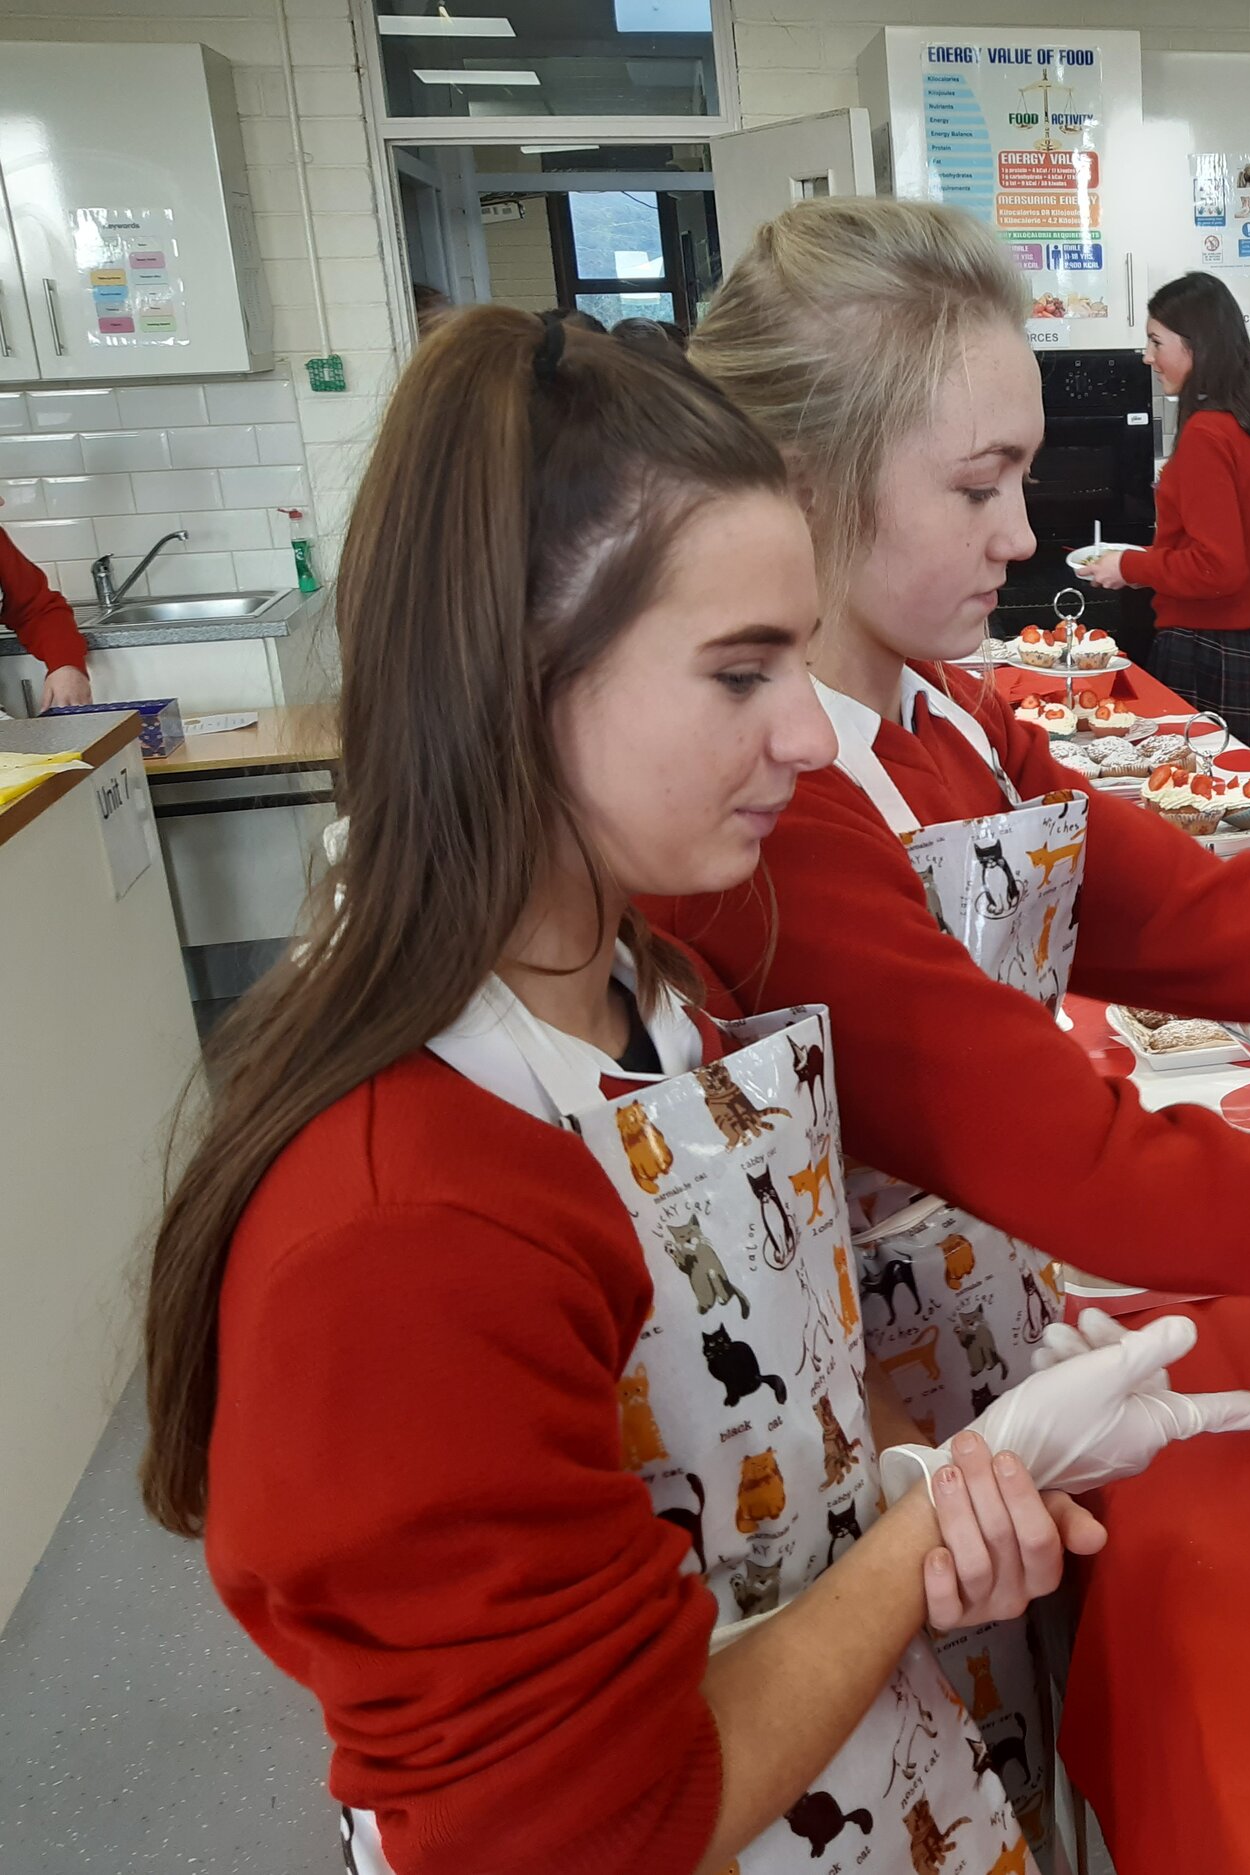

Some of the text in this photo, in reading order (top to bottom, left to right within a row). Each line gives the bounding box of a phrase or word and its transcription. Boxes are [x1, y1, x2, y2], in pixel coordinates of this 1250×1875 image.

[988, 48, 1032, 64] VALUE
[1037, 49, 1054, 65] OF
[1060, 49, 1094, 66] FOOD
[1009, 113, 1039, 125] FOOD
[1051, 114, 1093, 125] ACTIVITY
[1001, 153, 1046, 164] ENERGY
[998, 196, 1097, 205] MEASURING ENEY
[96, 768, 130, 819] Unit 7
[719, 1416, 783, 1443] black cat
[924, 1749, 941, 1773] cat
[856, 1845, 872, 1865] cat
